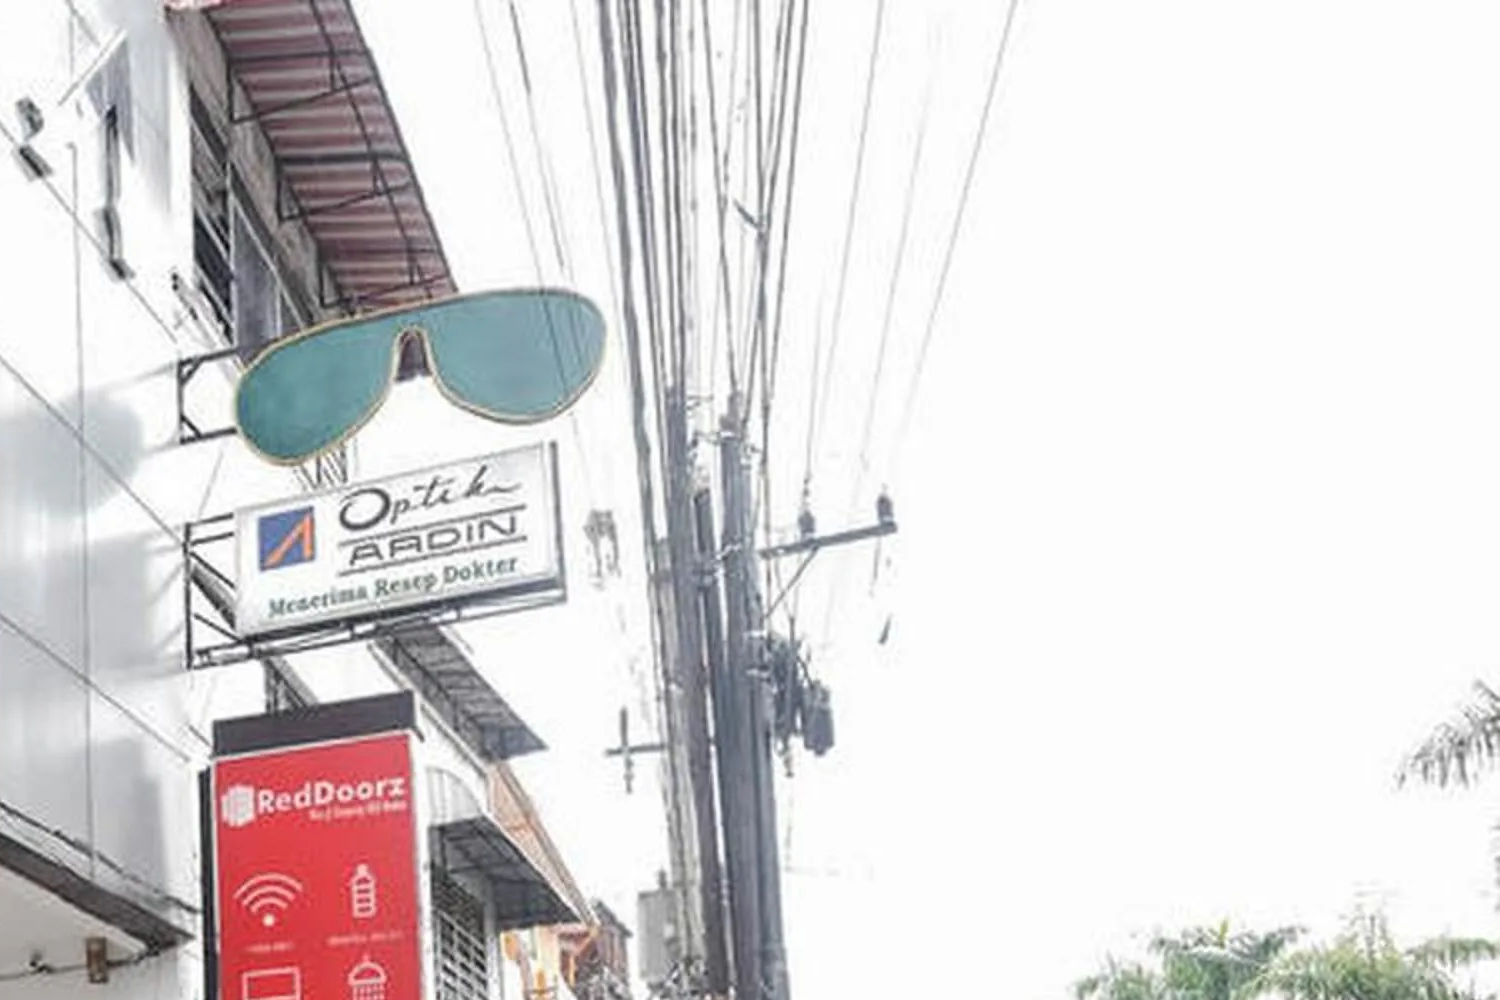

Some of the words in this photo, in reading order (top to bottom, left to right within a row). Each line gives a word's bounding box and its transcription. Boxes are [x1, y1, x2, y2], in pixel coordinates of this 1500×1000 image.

[339, 464, 522, 531] Optik
[267, 587, 368, 618] Menerima
[374, 573, 438, 599] Resep
[442, 556, 519, 585] Dokter
[257, 777, 405, 815] RedDoorz
